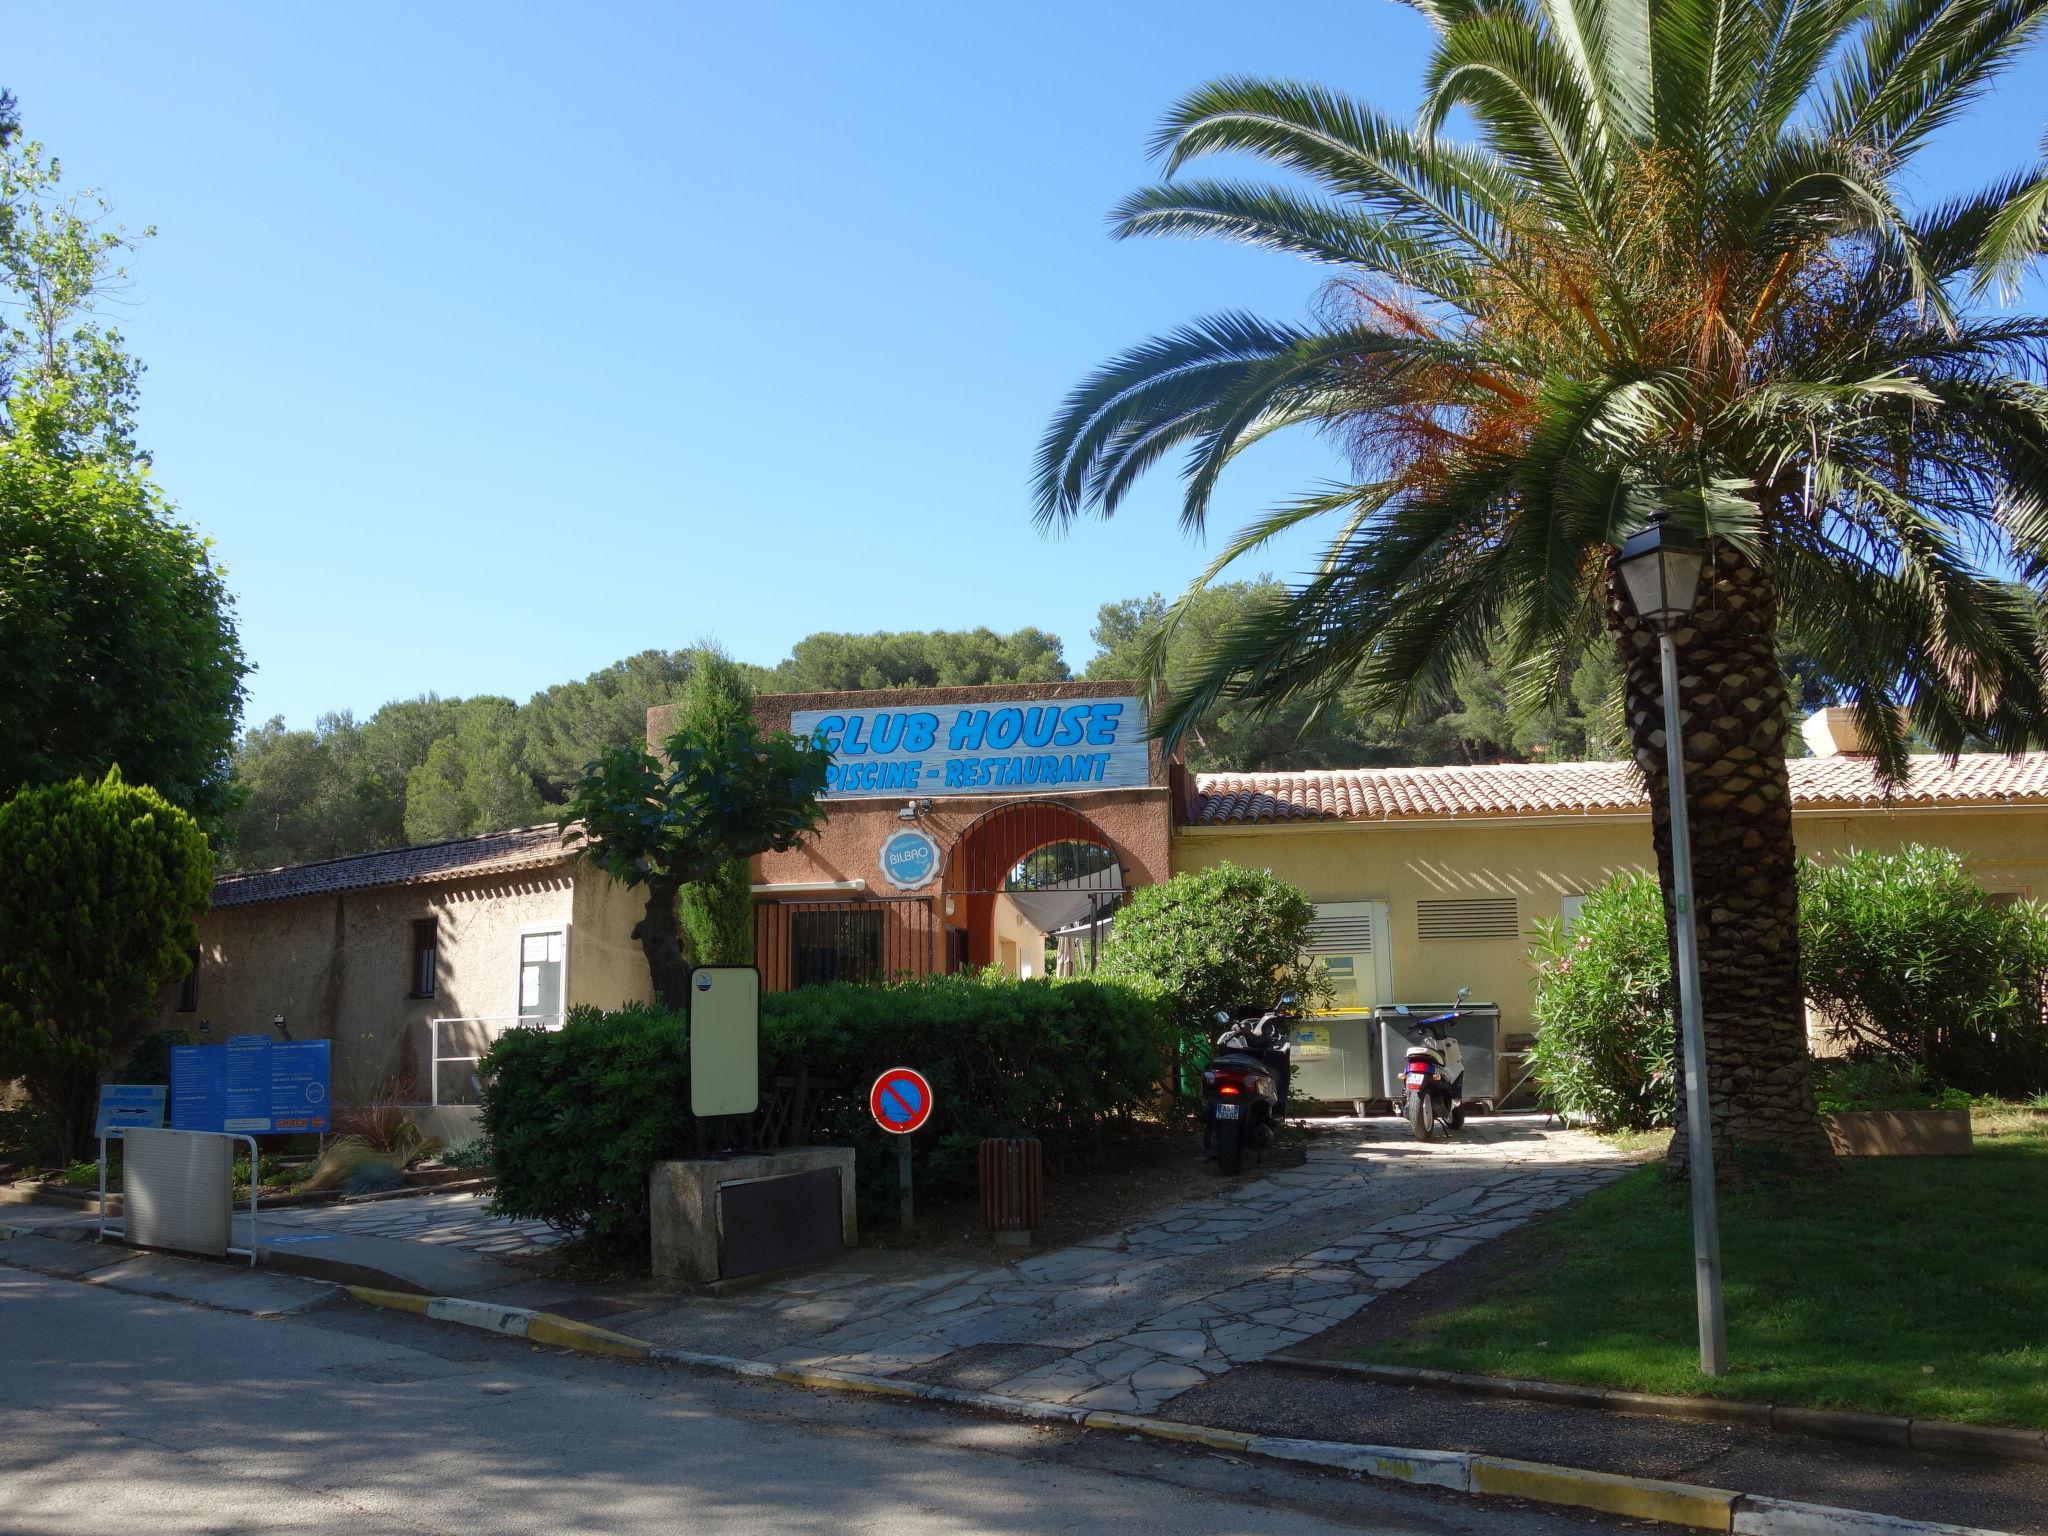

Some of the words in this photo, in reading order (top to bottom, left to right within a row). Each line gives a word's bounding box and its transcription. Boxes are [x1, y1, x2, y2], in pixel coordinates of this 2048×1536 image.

[811, 712, 940, 755] CLUB
[948, 703, 1125, 751] HOUSE
[824, 760, 923, 793] PISCINE
[944, 752, 1111, 788] RESTAURANT
[889, 847, 929, 865] BILBAO
